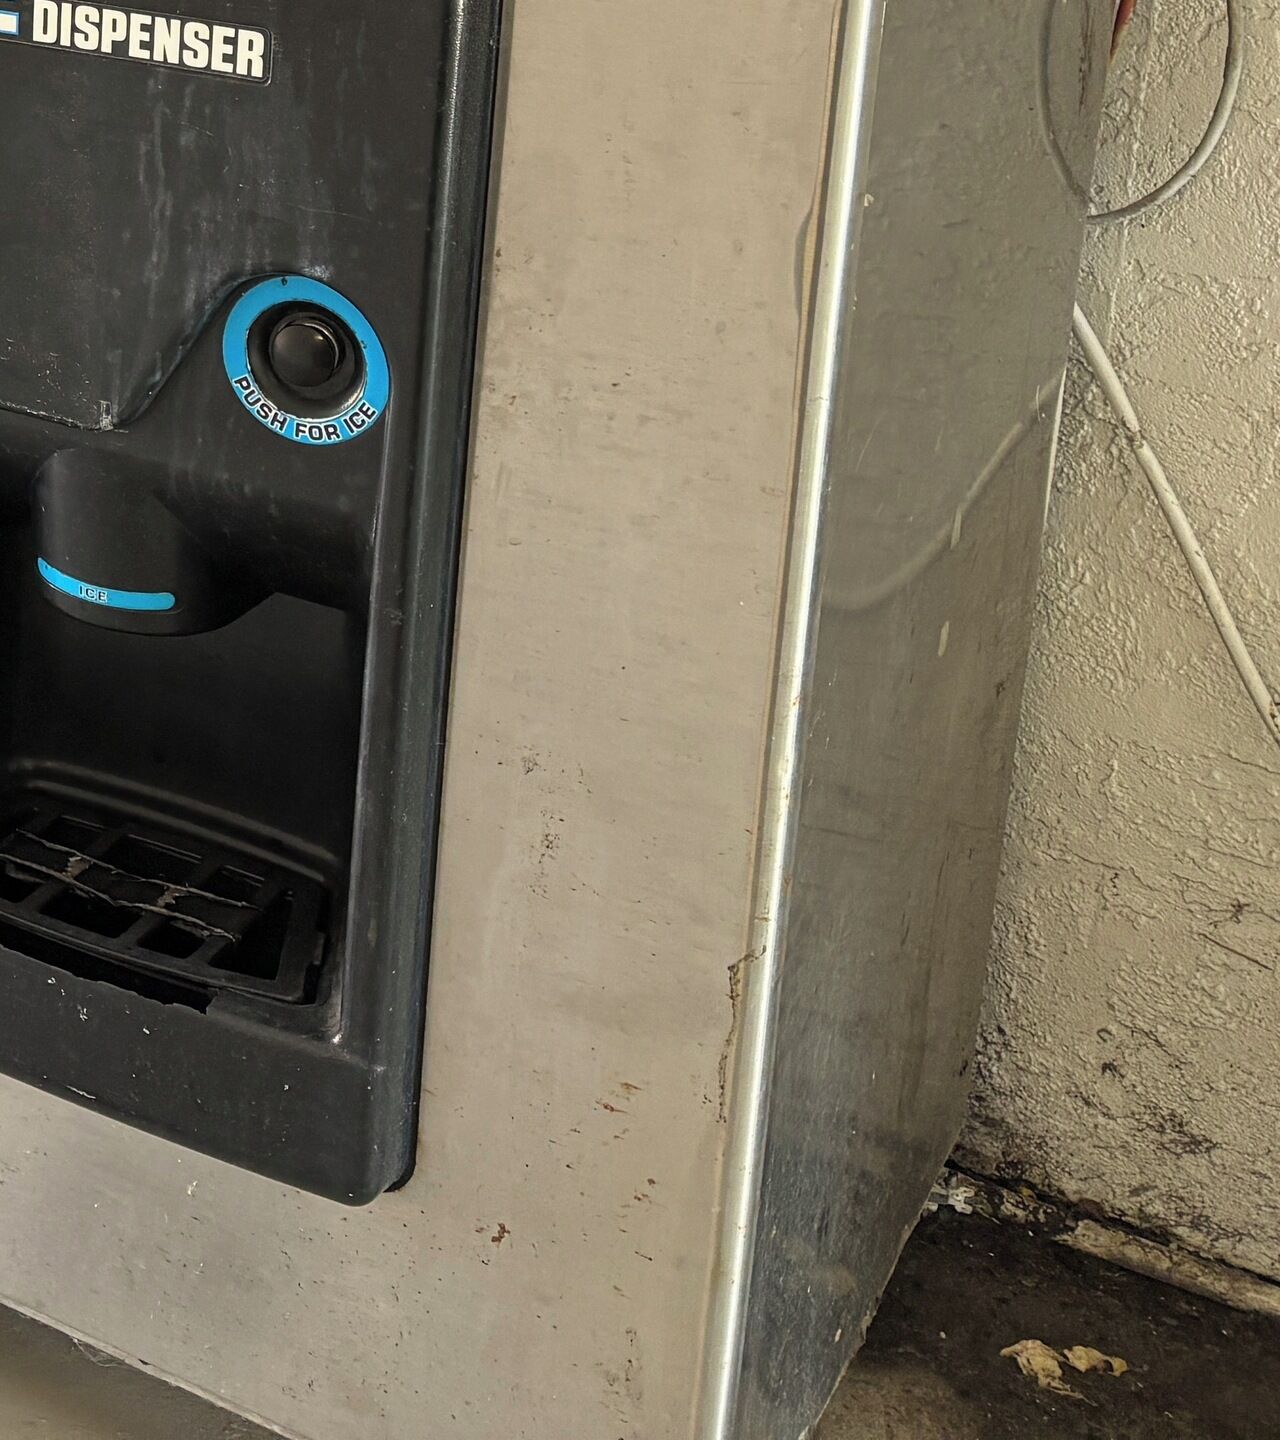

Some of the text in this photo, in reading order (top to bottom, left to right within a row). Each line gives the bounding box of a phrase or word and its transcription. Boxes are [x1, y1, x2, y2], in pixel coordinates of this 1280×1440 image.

[234, 375, 378, 442] PUSH FOR ICE
[79, 585, 107, 602] ICE
